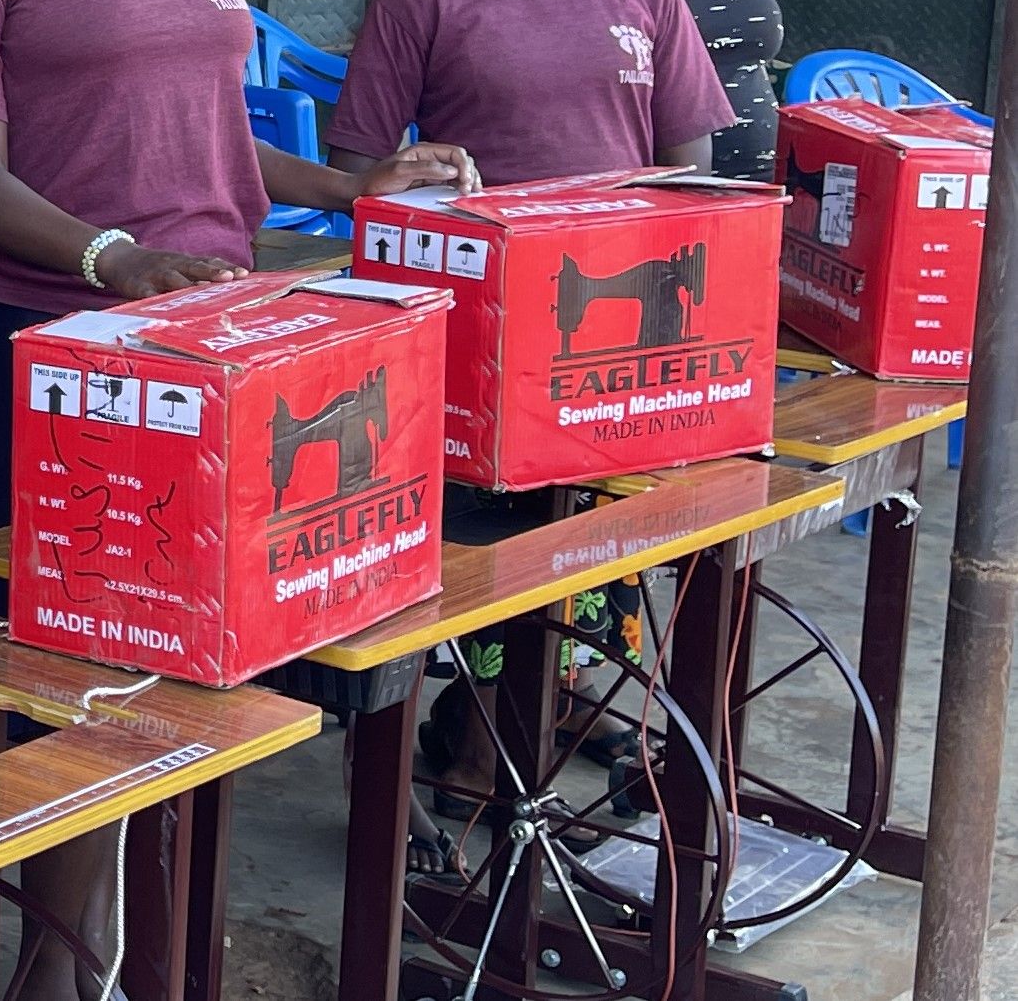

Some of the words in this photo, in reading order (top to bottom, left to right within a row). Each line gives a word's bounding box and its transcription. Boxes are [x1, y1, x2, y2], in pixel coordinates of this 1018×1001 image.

[34, 367, 50, 377] THIS
[69, 373, 80, 382] UP
[550, 346, 754, 403] EAGLEFLY
[911, 349, 964, 366] MADE
[557, 402, 625, 428] Sewing
[628, 388, 704, 417] Machine
[707, 378, 754, 404] Head
[592, 421, 646, 444] MADE
[648, 417, 666, 436] IN
[669, 408, 716, 432] INDIA
[40, 460, 50, 472] G.
[445, 438, 472, 459] DIA
[267, 483, 427, 576] EAGLEFLY
[274, 565, 329, 603] Sewing
[332, 540, 392, 580] Machine
[393, 521, 427, 556] Head
[36, 607, 95, 637] MADE
[100, 618, 123, 643] IN
[128, 624, 184, 656] INDIA
